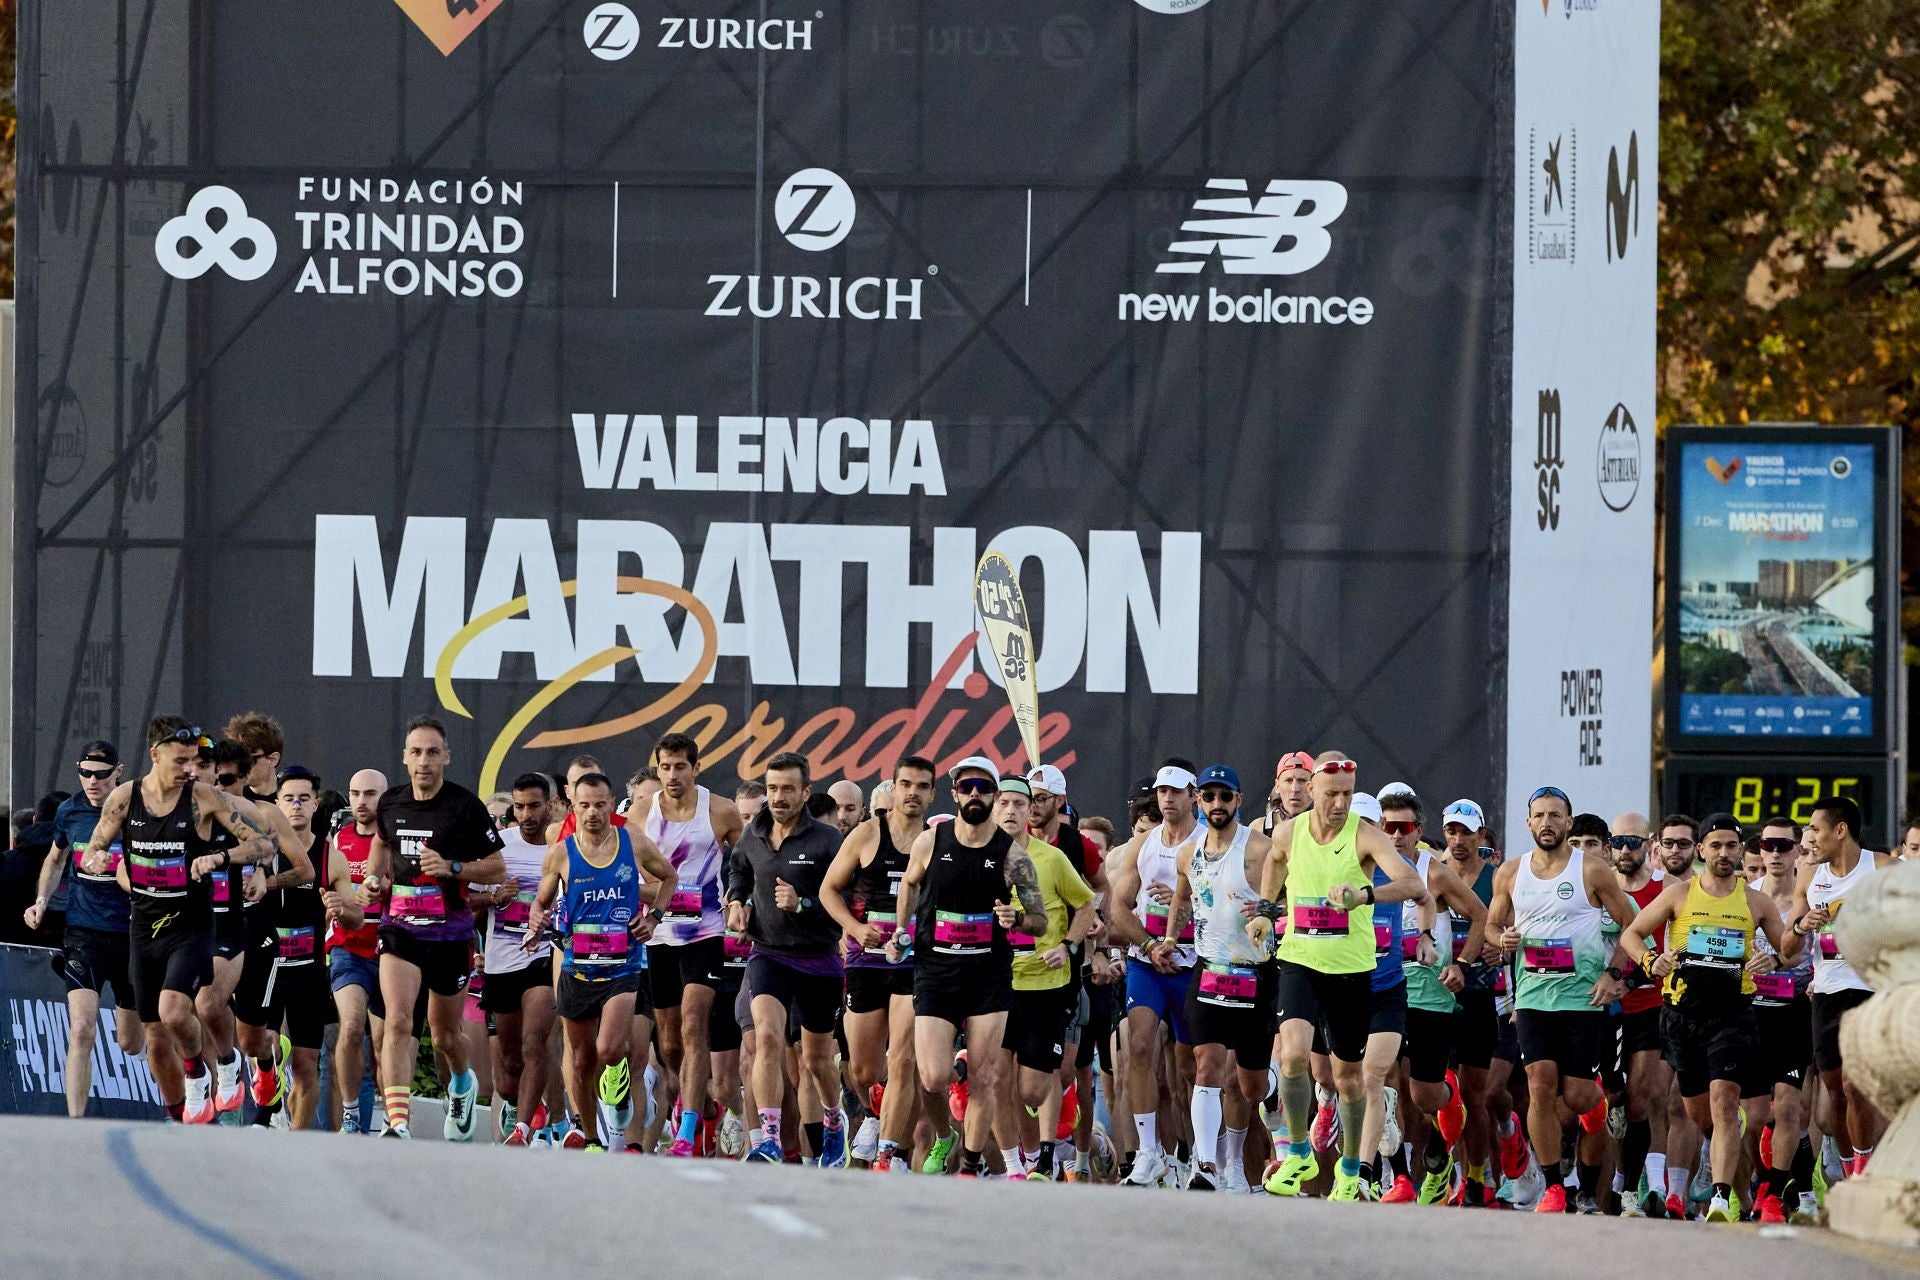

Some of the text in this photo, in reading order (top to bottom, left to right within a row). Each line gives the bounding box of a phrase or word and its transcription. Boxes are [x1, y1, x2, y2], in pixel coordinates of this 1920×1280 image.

[657, 17, 813, 51] ZURICH
[299, 175, 523, 206] FUNDACIÓN
[294, 211, 525, 254] TRINIDAD
[294, 256, 525, 298] ALFONSO
[704, 274, 923, 321] ZURICH
[1118, 286, 1375, 325] new balance
[571, 413, 948, 497] VALENCIA
[1728, 512, 1824, 533] MARATHON
[312, 513, 1203, 695] MARATHON
[1560, 668, 1603, 717] POWER
[1579, 719, 1603, 767] ADE
[583, 886, 626, 904] FIAAL
[1706, 936, 1728, 948] 4598
[1708, 947, 1724, 956] Dani
